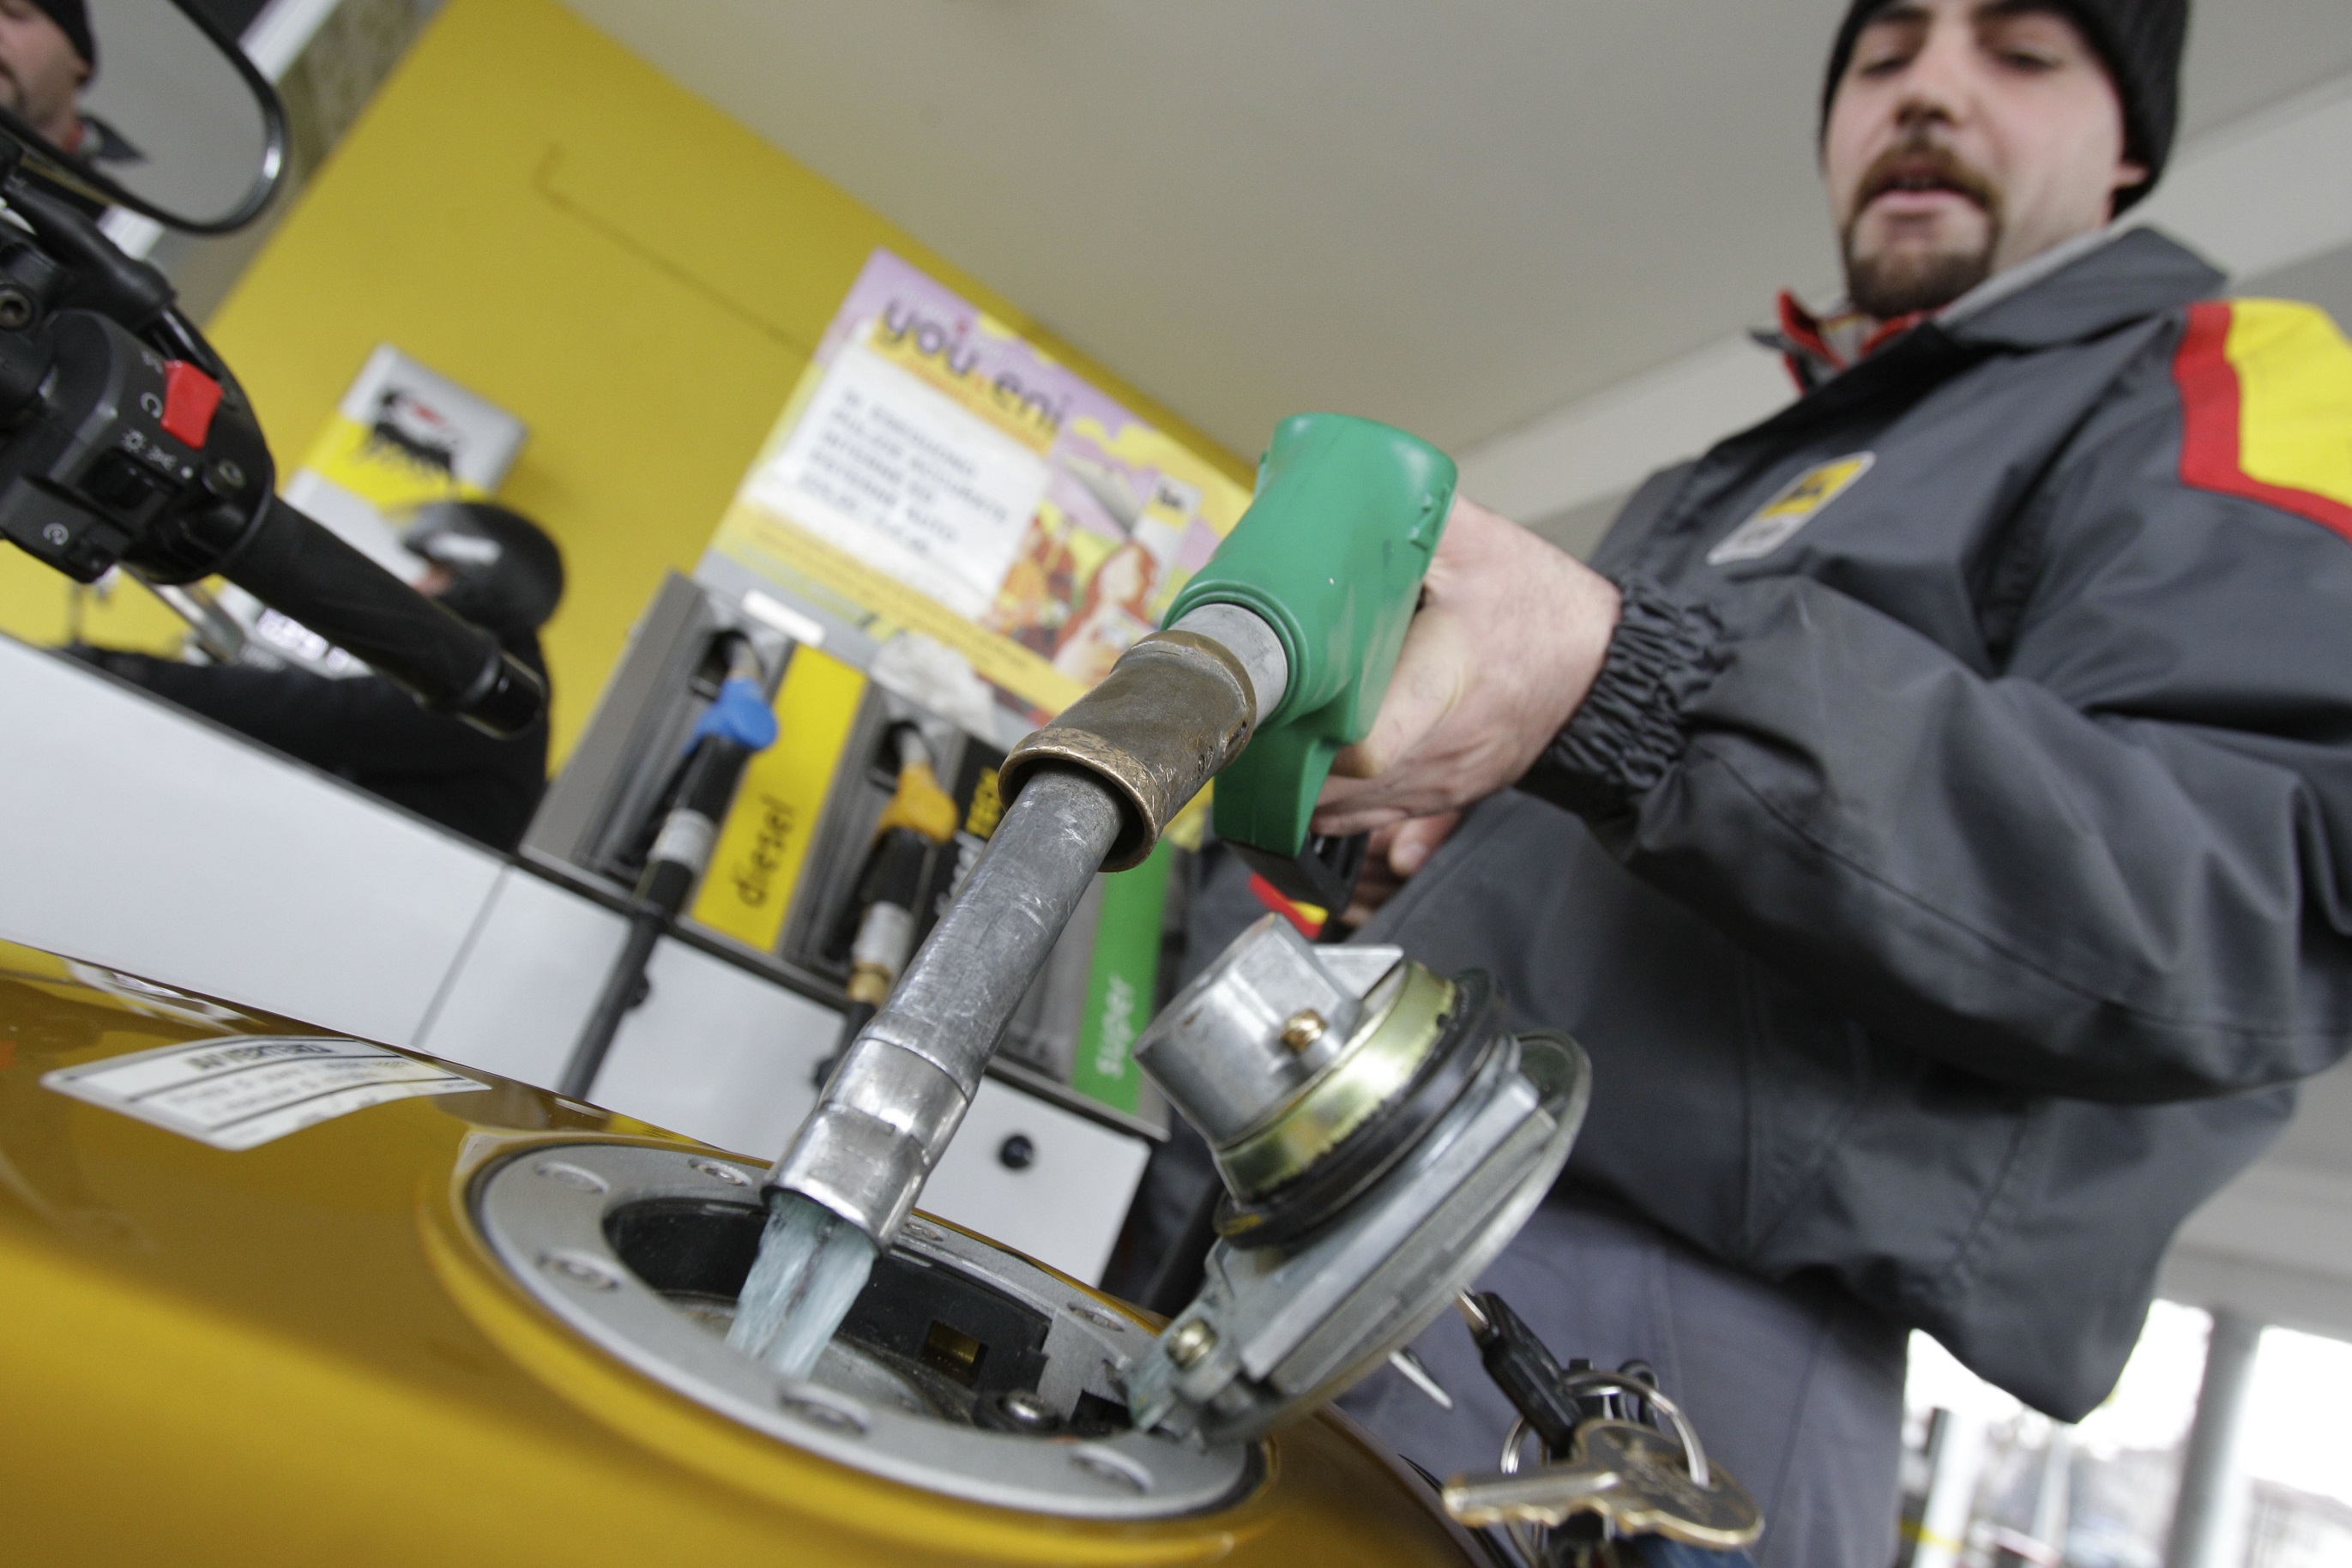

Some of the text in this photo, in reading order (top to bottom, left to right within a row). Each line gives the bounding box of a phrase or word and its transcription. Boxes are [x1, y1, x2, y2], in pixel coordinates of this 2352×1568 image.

[884, 298, 977, 376] you
[992, 371, 1074, 432] eni
[730, 792, 799, 909] diesel
[1095, 972, 1137, 1082] super
